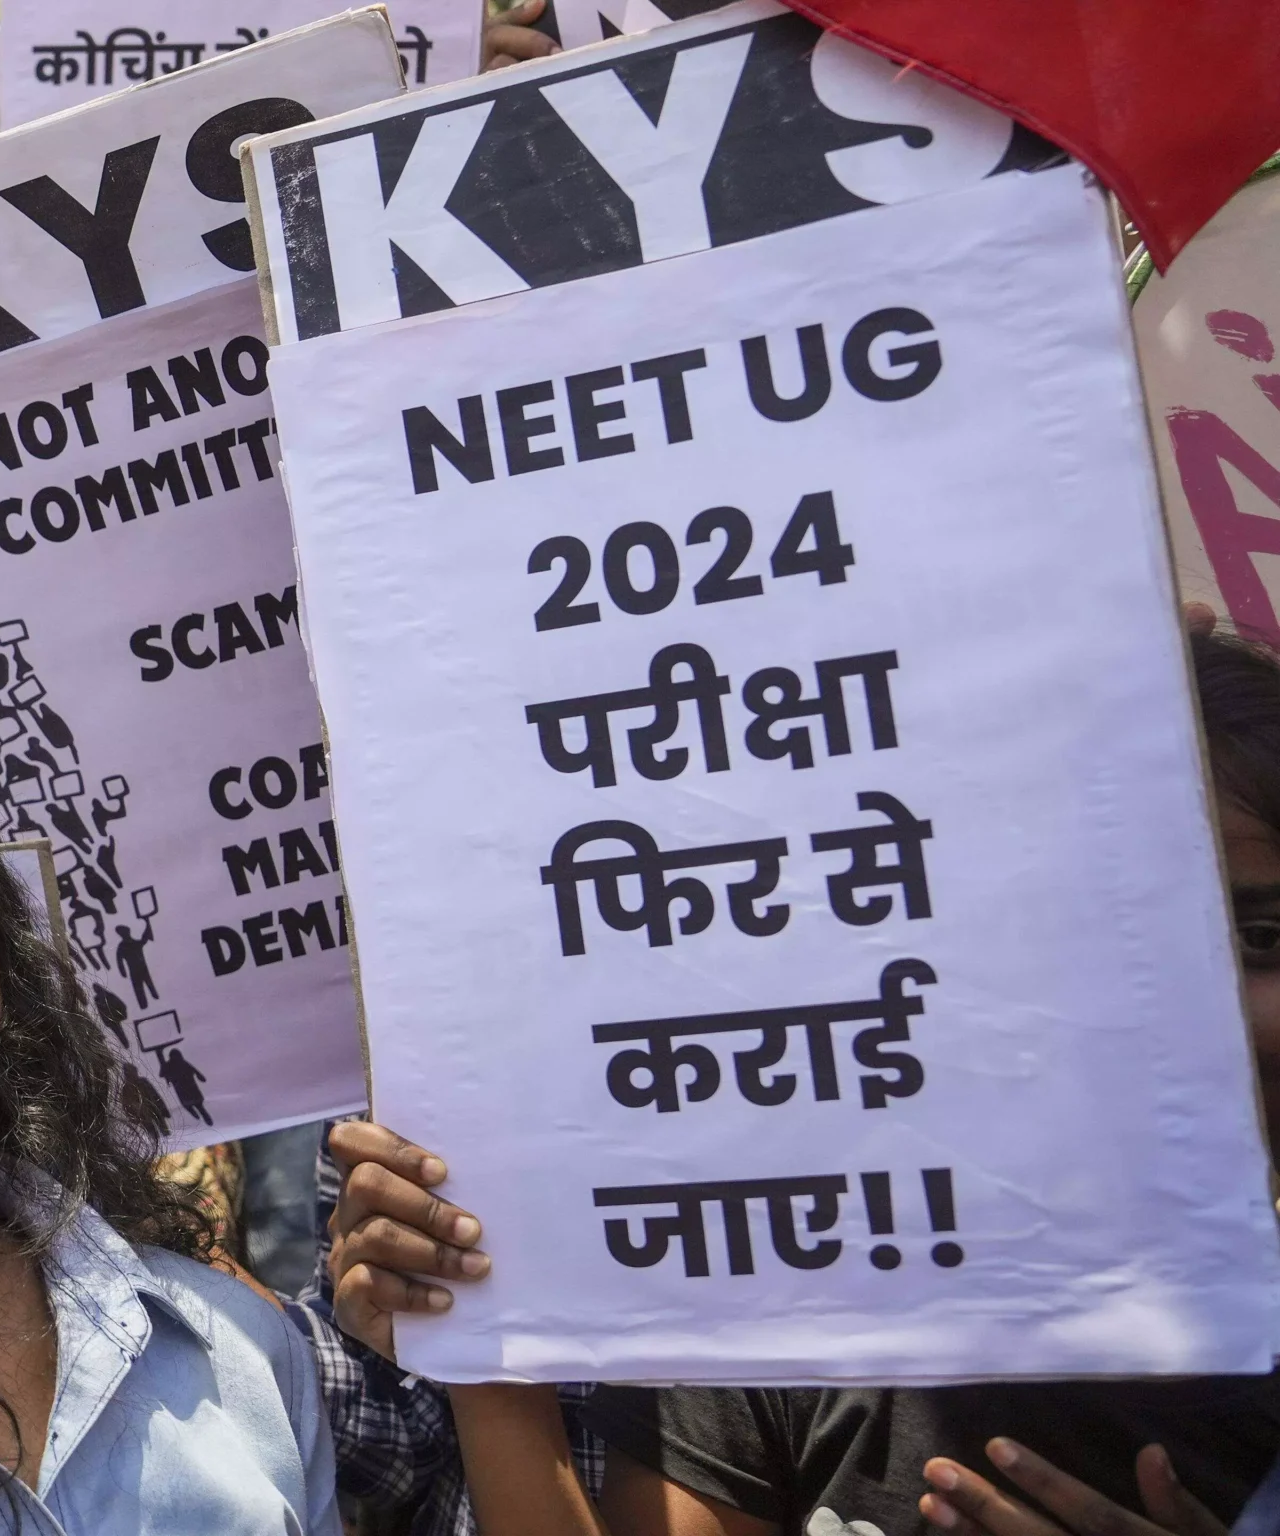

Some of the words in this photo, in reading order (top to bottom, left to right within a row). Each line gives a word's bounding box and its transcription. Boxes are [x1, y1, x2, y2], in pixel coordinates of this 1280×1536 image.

[313, 30, 1013, 330] KYS
[126, 335, 270, 431] ANO
[401, 348, 707, 494] NEET
[741, 306, 943, 422] UG
[130, 585, 301, 682] SCAM
[527, 490, 855, 632] 2024
[525, 642, 900, 789] परीक्षा
[539, 819, 788, 956] फिर
[811, 791, 933, 929] से
[592, 957, 938, 1114] कराई
[592, 1168, 965, 1278] जाए!!
